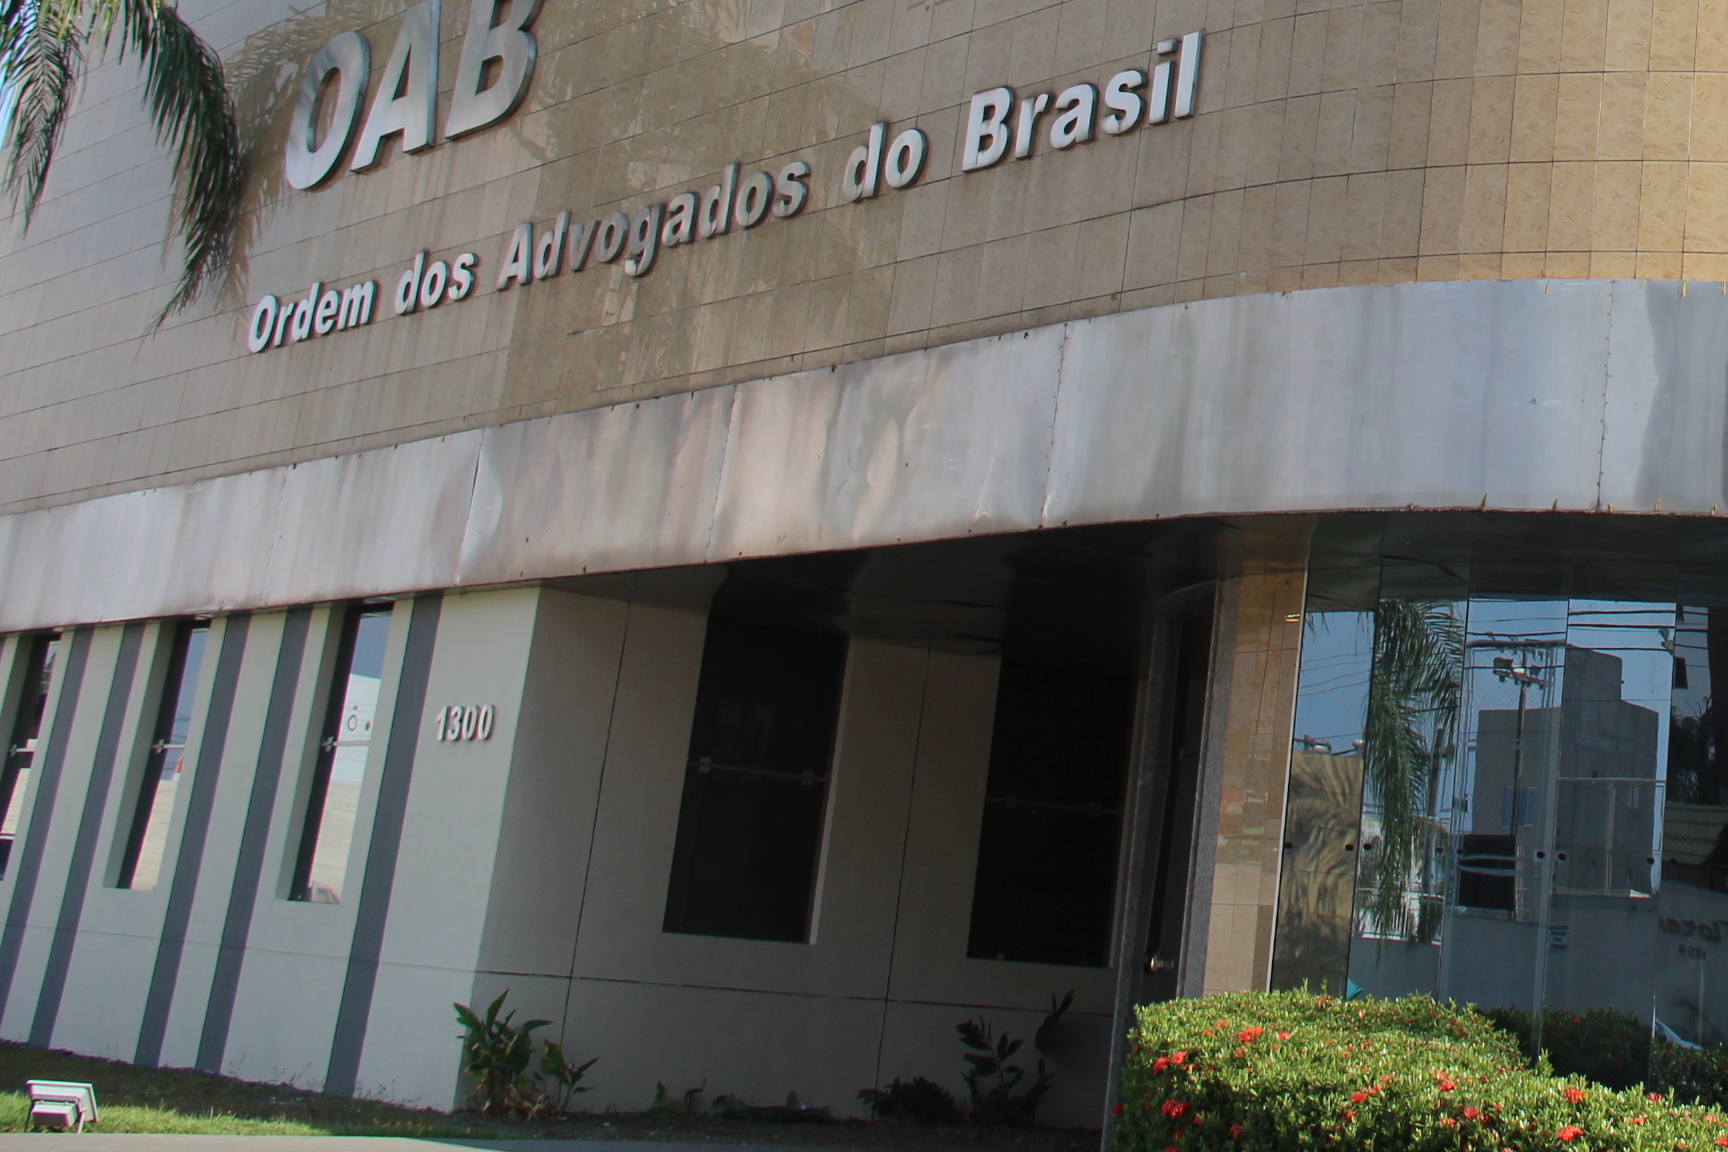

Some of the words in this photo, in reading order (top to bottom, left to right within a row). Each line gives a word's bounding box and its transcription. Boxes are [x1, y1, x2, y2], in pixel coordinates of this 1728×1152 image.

[248, 279, 379, 354] Ordem
[394, 250, 478, 315] dos
[497, 162, 811, 291] Advogados
[842, 121, 929, 204] do
[960, 28, 1206, 174] Brasil
[436, 704, 497, 742] 1300
